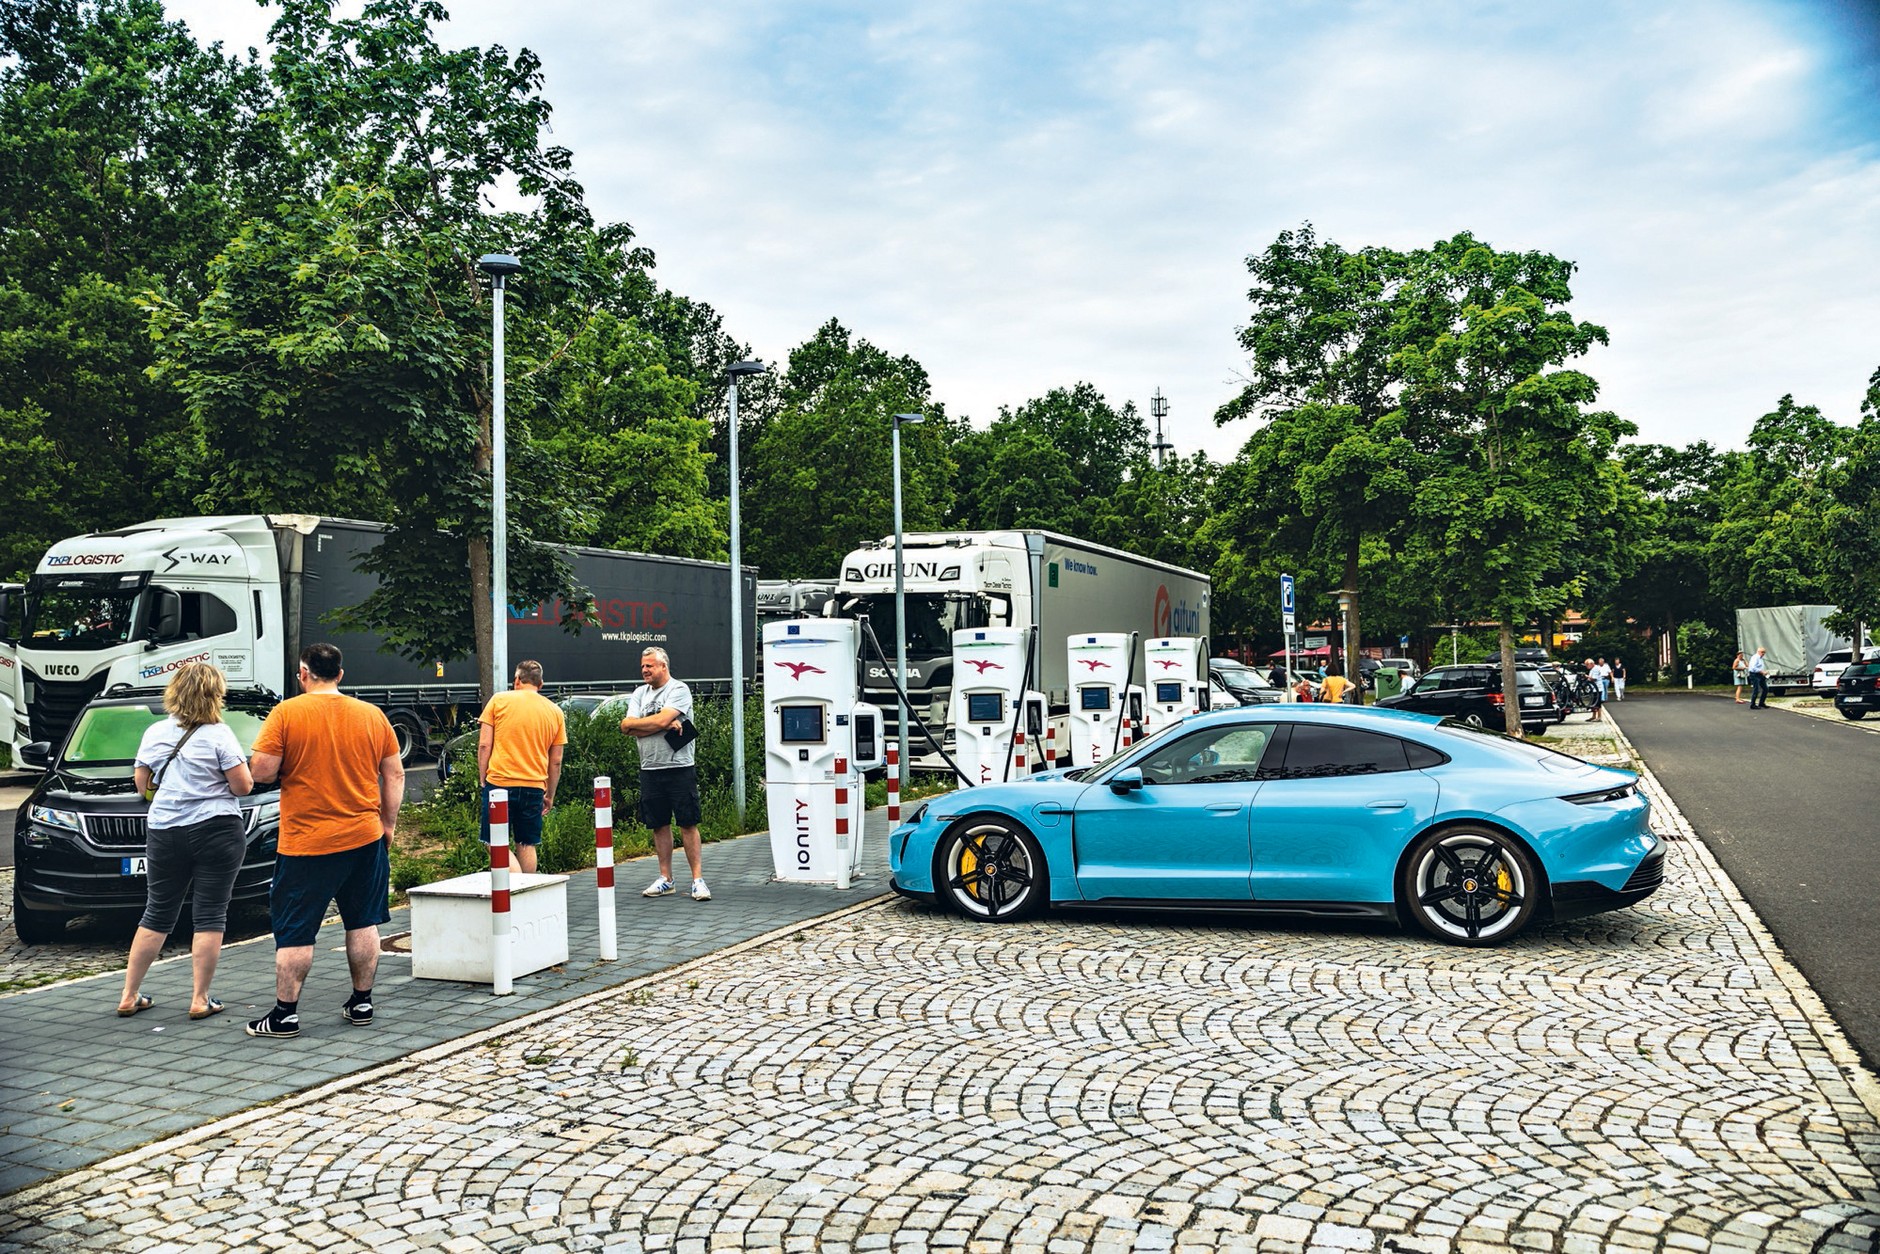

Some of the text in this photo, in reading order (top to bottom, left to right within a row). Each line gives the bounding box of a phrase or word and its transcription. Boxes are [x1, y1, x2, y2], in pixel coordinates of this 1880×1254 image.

[162, 546, 232, 573] S-WAY
[1065, 558, 1073, 571] We
[1074, 560, 1086, 574] know
[1174, 599, 1200, 638] gifuni
[601, 631, 668, 644] www.tkplogistic.com
[45, 664, 80, 676] IVECO
[869, 667, 922, 679] SCAIA
[773, 706, 780, 715] 4
[136, 859, 147, 873] A
